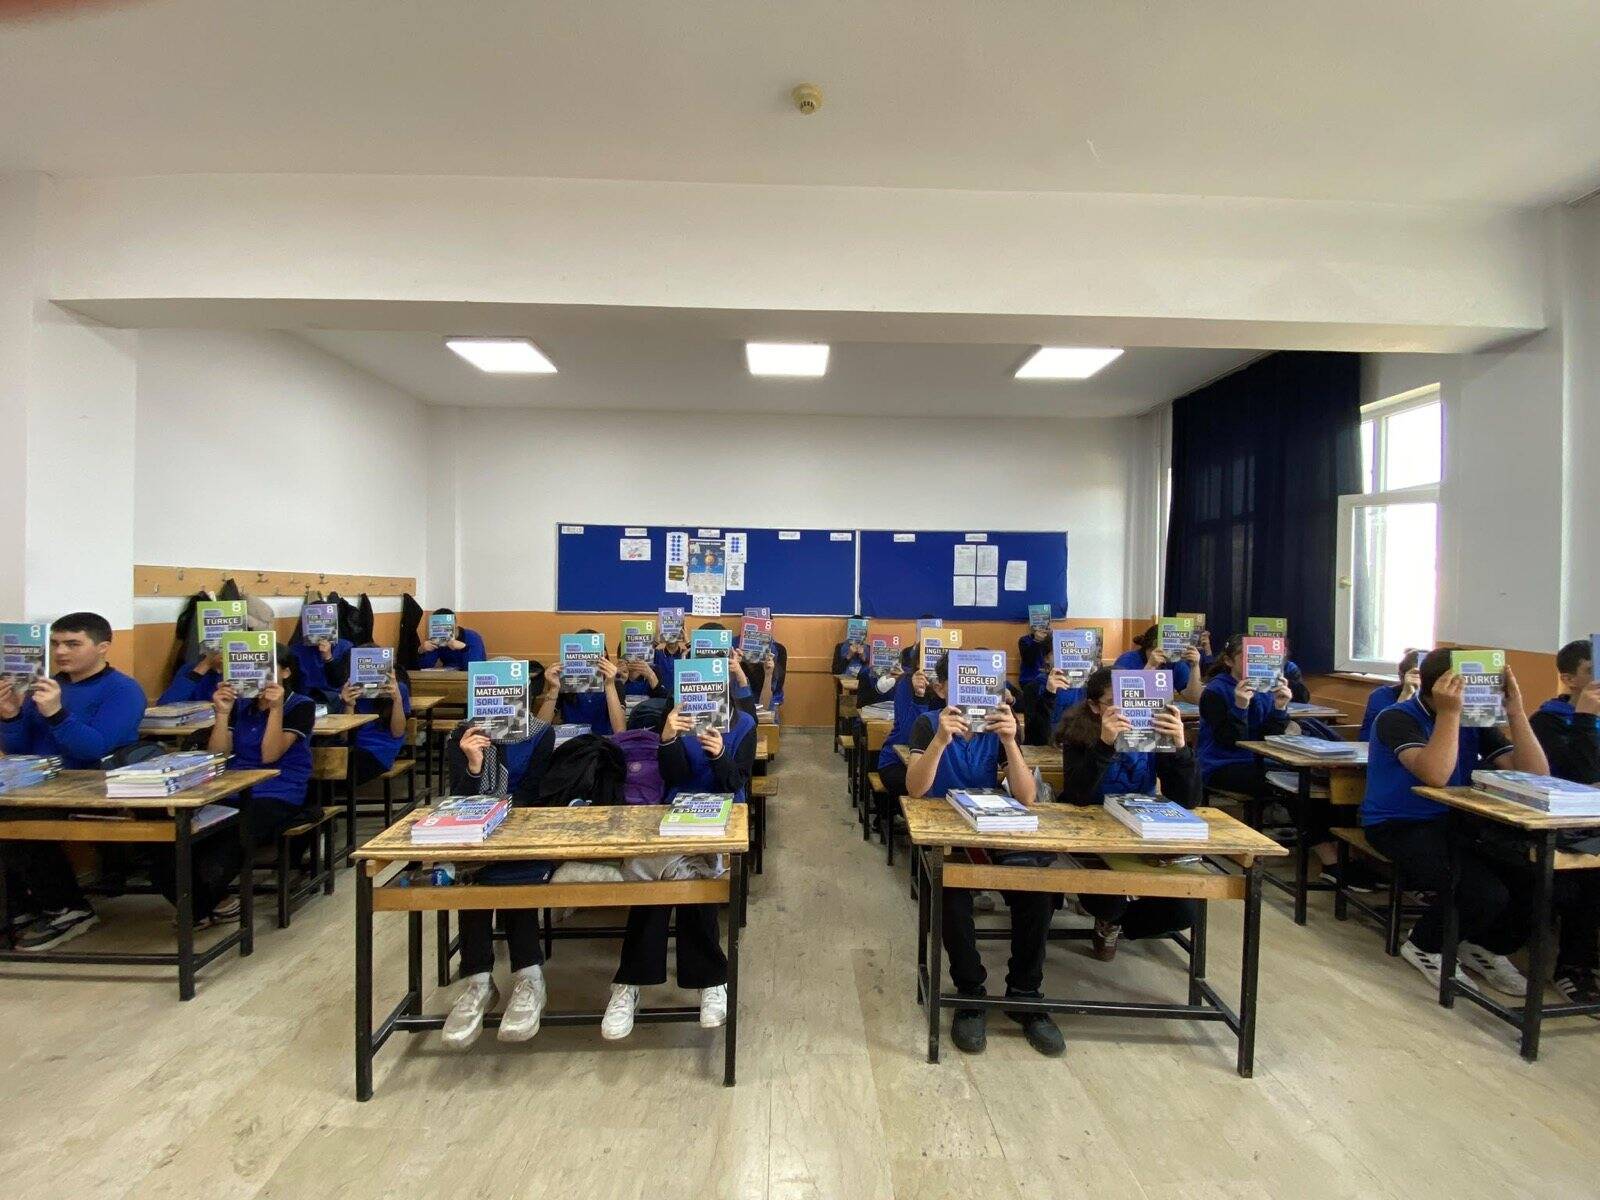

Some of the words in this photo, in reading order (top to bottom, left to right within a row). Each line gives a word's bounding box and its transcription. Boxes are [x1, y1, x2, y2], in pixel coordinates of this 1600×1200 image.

[232, 602, 241, 612] 8
[327, 605, 334, 613] 8
[677, 608, 682, 616] 8
[761, 608, 767, 616] 8
[206, 617, 239, 625] TÜRKÇE
[765, 621, 771, 630] 8
[1184, 619, 1190, 628] 8
[1276, 620, 1284, 628] 8
[646, 621, 653, 631] 8
[31, 624, 41, 638] 8
[258, 633, 269, 646] 8
[592, 635, 599, 646] 8
[720, 631, 728, 642] 8
[893, 636, 899, 645] 8
[949, 631, 958, 642] 8
[1085, 631, 1093, 642] 8
[1273, 640, 1280, 650] 8
[231, 653, 266, 662] TÜRKÇE
[382, 649, 390, 659] 8
[992, 654, 1002, 669] 8
[1492, 653, 1502, 667] 8
[511, 663, 522, 678] 8
[712, 659, 723, 674] 8
[960, 676, 996, 685] DERSLER
[1155, 672, 1167, 687] 8
[1464, 675, 1500, 685] TÜRKÇE
[476, 687, 521, 696] MATEMATİK
[682, 684, 723, 692] MATEMATİK
[960, 686, 982, 694] SORU
[682, 694, 703, 702] SORU
[1124, 690, 1140, 698] FEN
[477, 698, 499, 706] SORU
[960, 696, 996, 705] BANKASI
[1124, 699, 1160, 707] BİLİMLERİ
[476, 707, 512, 716] BANKASI
